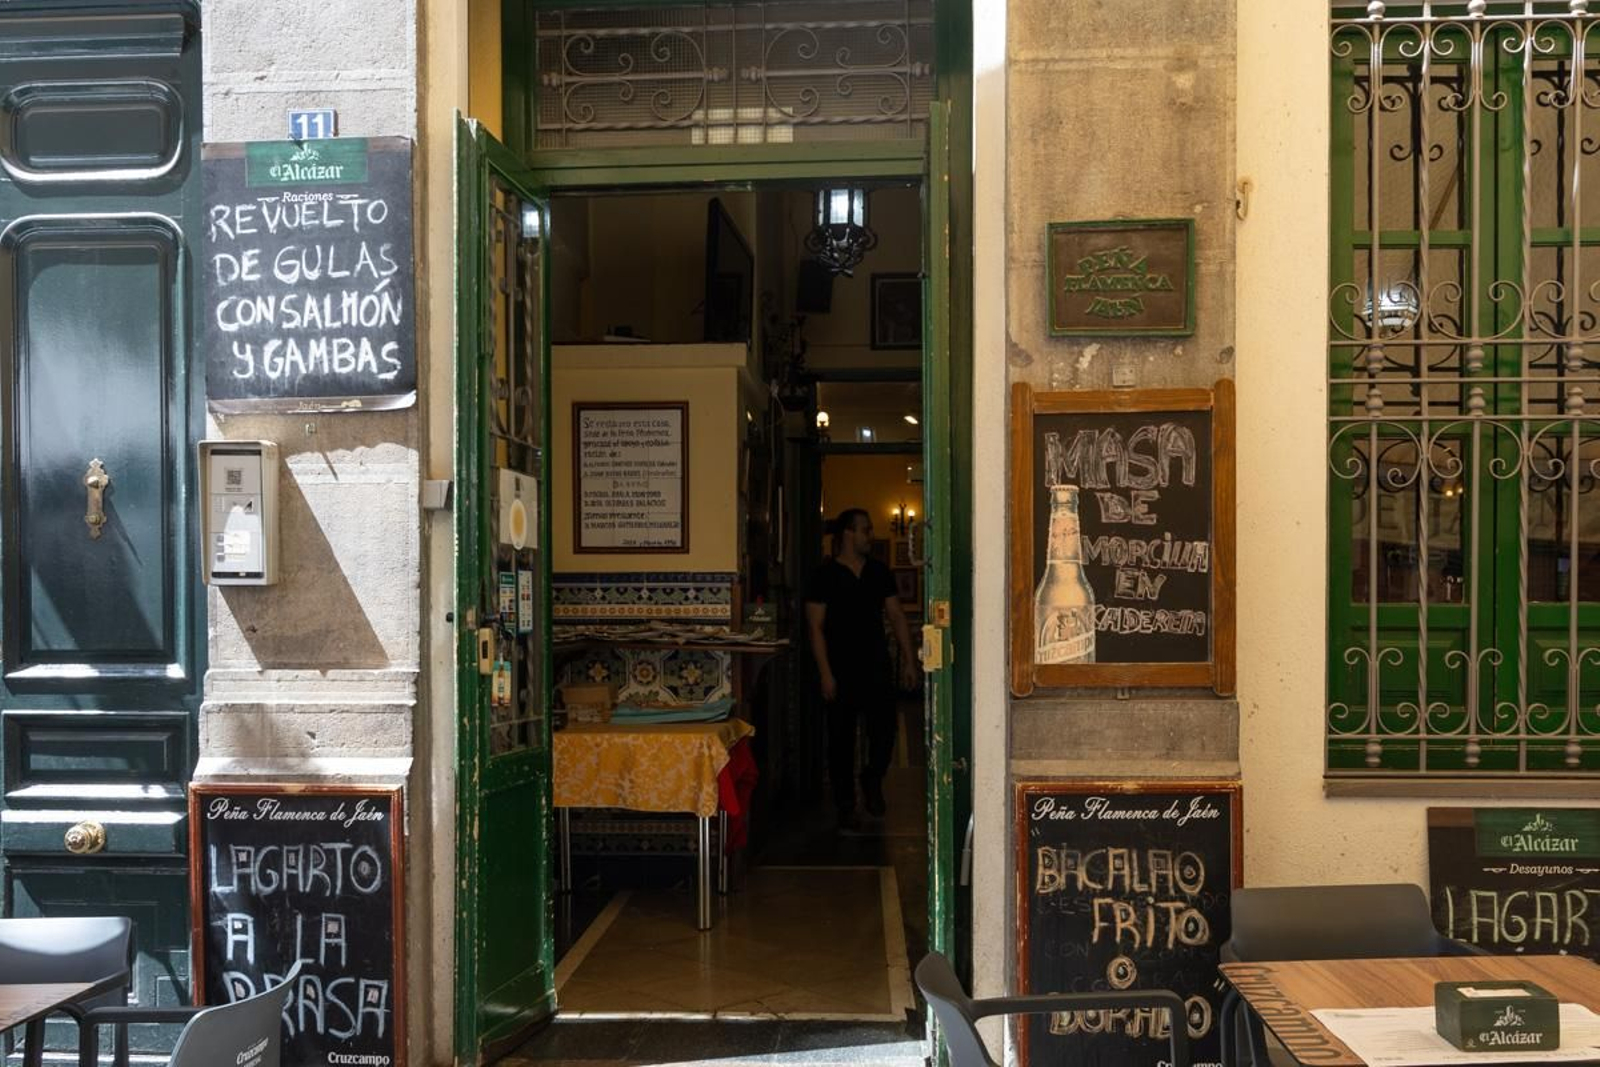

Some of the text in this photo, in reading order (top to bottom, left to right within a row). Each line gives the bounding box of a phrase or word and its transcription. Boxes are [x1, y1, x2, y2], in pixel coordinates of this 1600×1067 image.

[295, 113, 325, 140] 11
[281, 163, 344, 181] Alcázar
[282, 190, 334, 203] Raciones
[210, 199, 388, 243] REVUELTO
[213, 241, 399, 287] DE GULAS
[216, 294, 276, 331] CON
[263, 336, 402, 380] GAMBAS
[1044, 423, 1197, 490] MASA
[1095, 489, 1161, 525] DE
[1114, 567, 1167, 600] EN
[1088, 603, 1206, 637] CALDERETA
[206, 797, 385, 828] Peña Flamenca de Jaén
[1031, 795, 1220, 827] Peña Flamenca de Jaén
[1513, 834, 1579, 852] Alcázar
[209, 841, 382, 897] LAGARTO
[1036, 842, 1206, 896] BACALAO
[1509, 863, 1574, 877] Desayunos
[225, 911, 347, 968] A LA
[1092, 895, 1210, 950] FRITO
[1488, 1030, 1543, 1046] Alcázar
[327, 1051, 390, 1067] Cruzcampo
